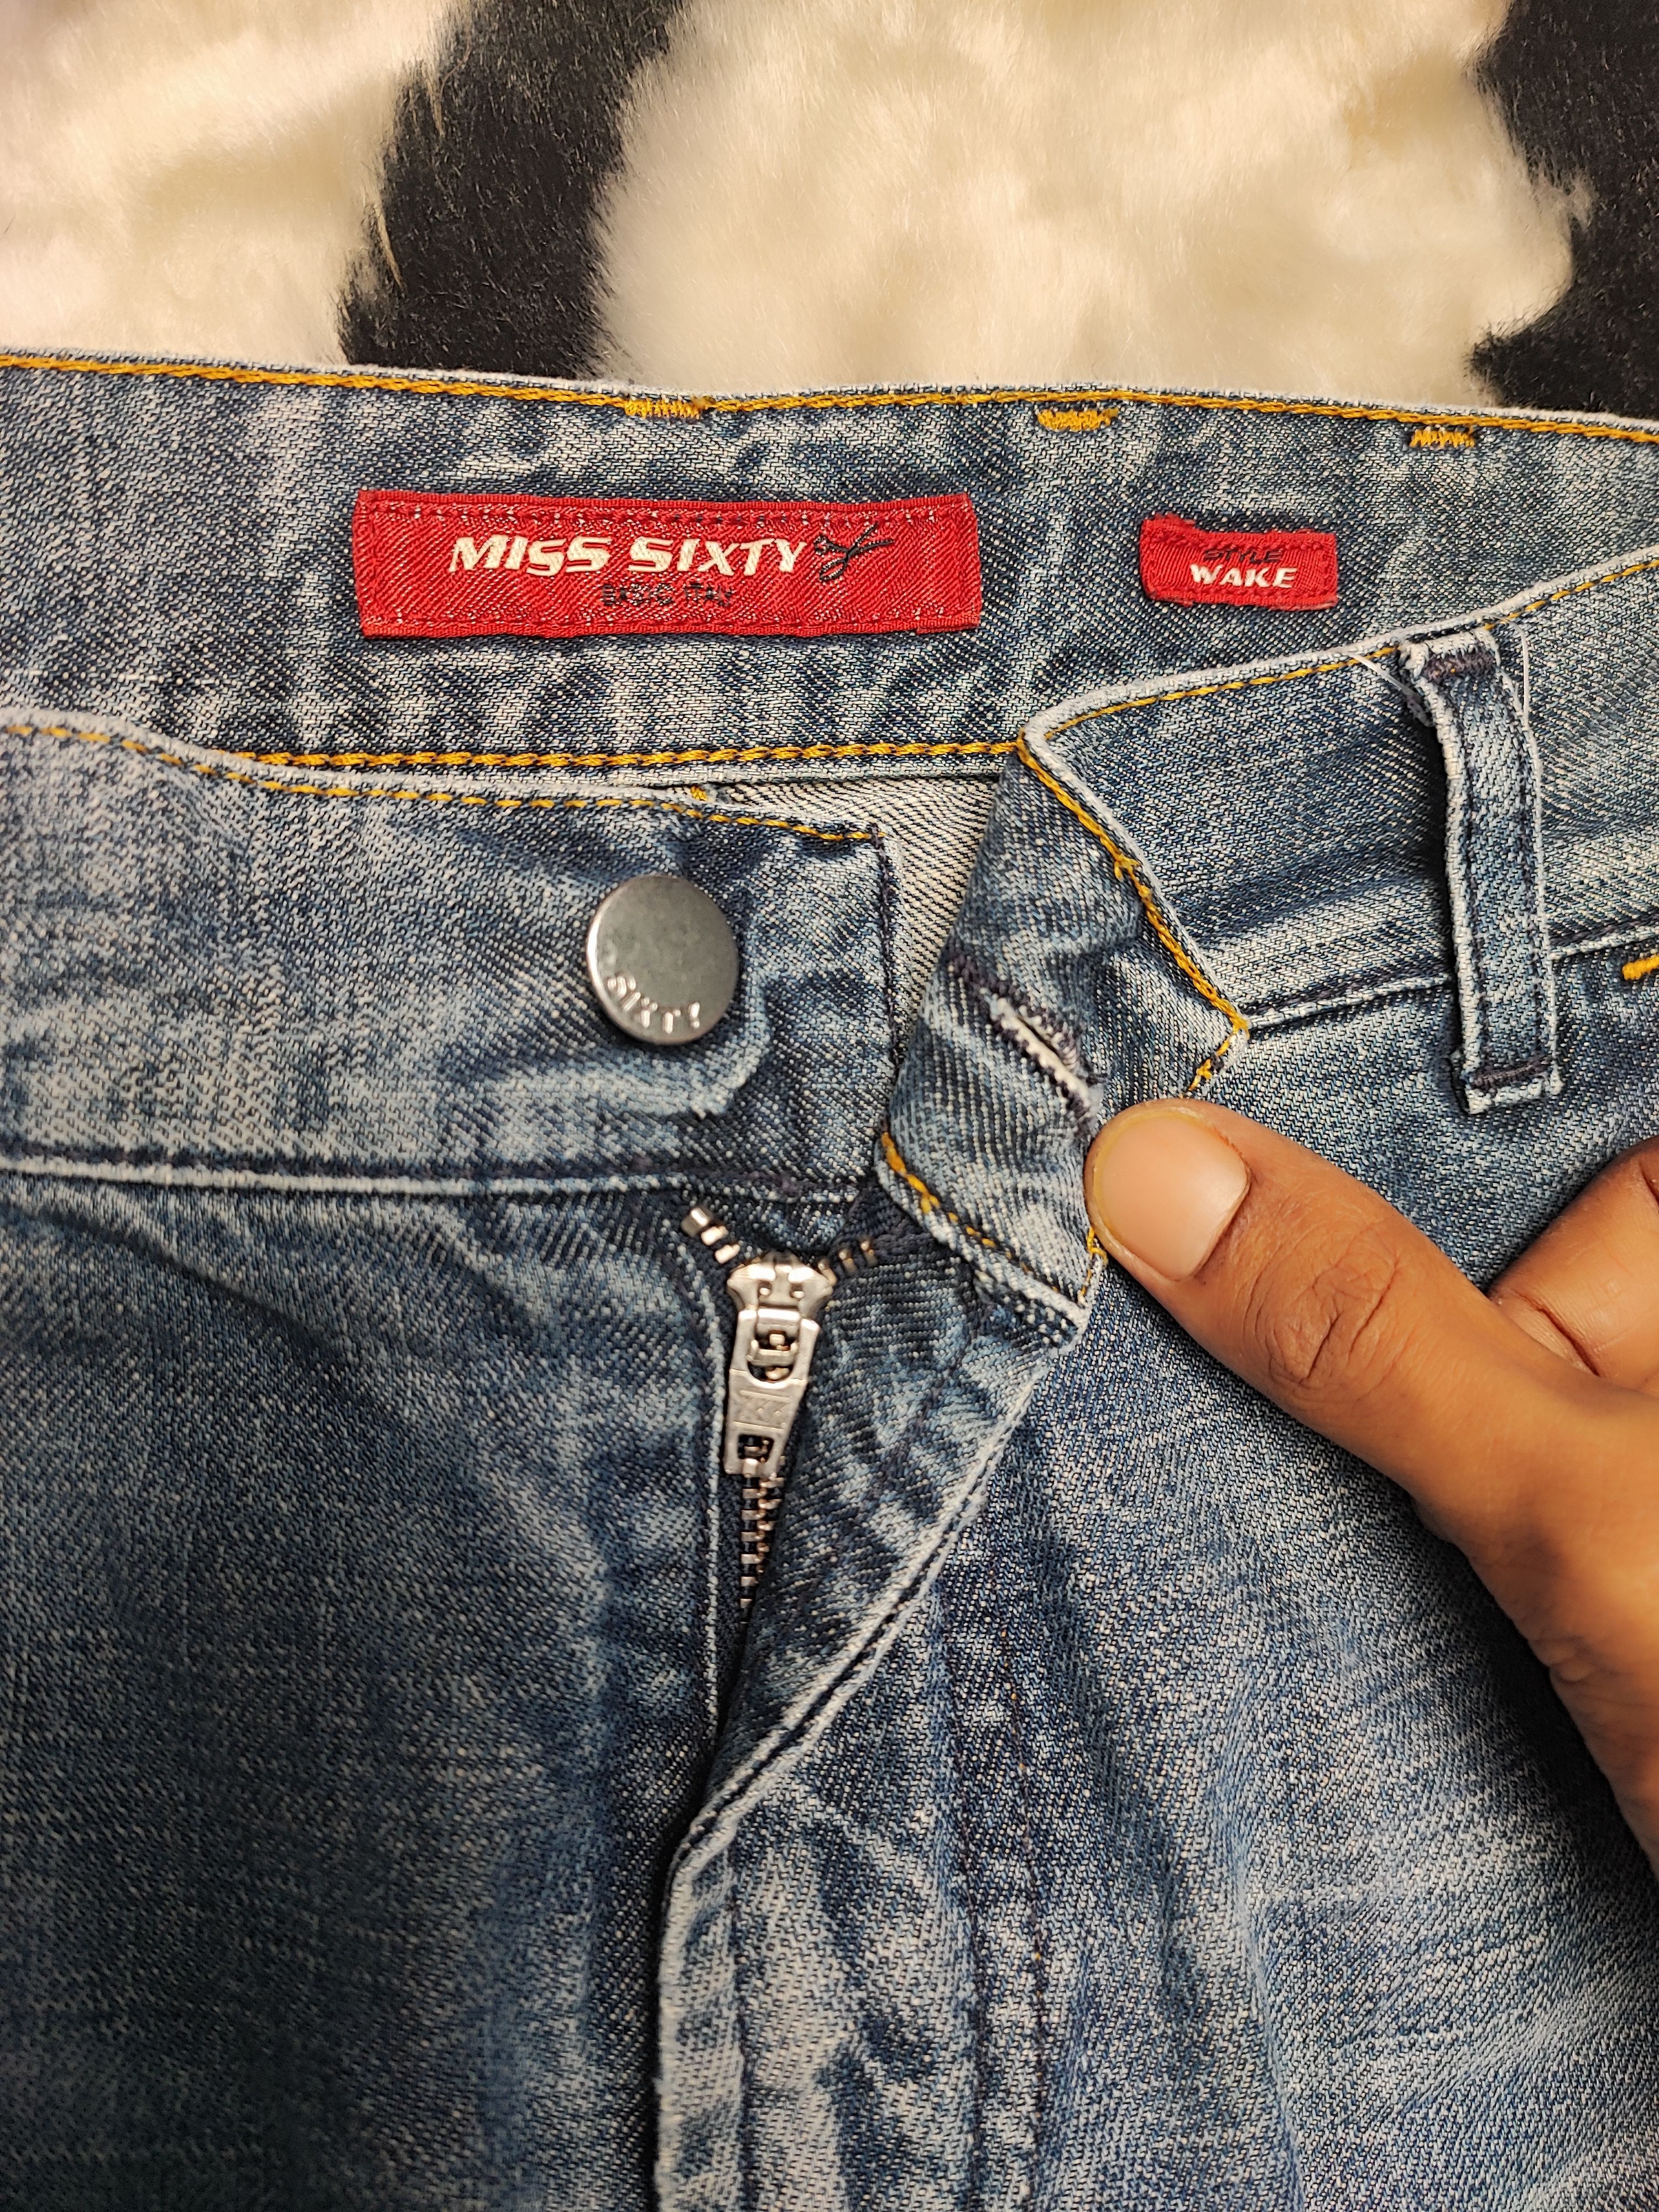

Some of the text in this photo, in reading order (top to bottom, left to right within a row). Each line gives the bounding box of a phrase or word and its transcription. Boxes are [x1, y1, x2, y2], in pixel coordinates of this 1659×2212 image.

[448, 534, 807, 576] MISS SIXTY
[1190, 564, 1297, 588] WAKE
